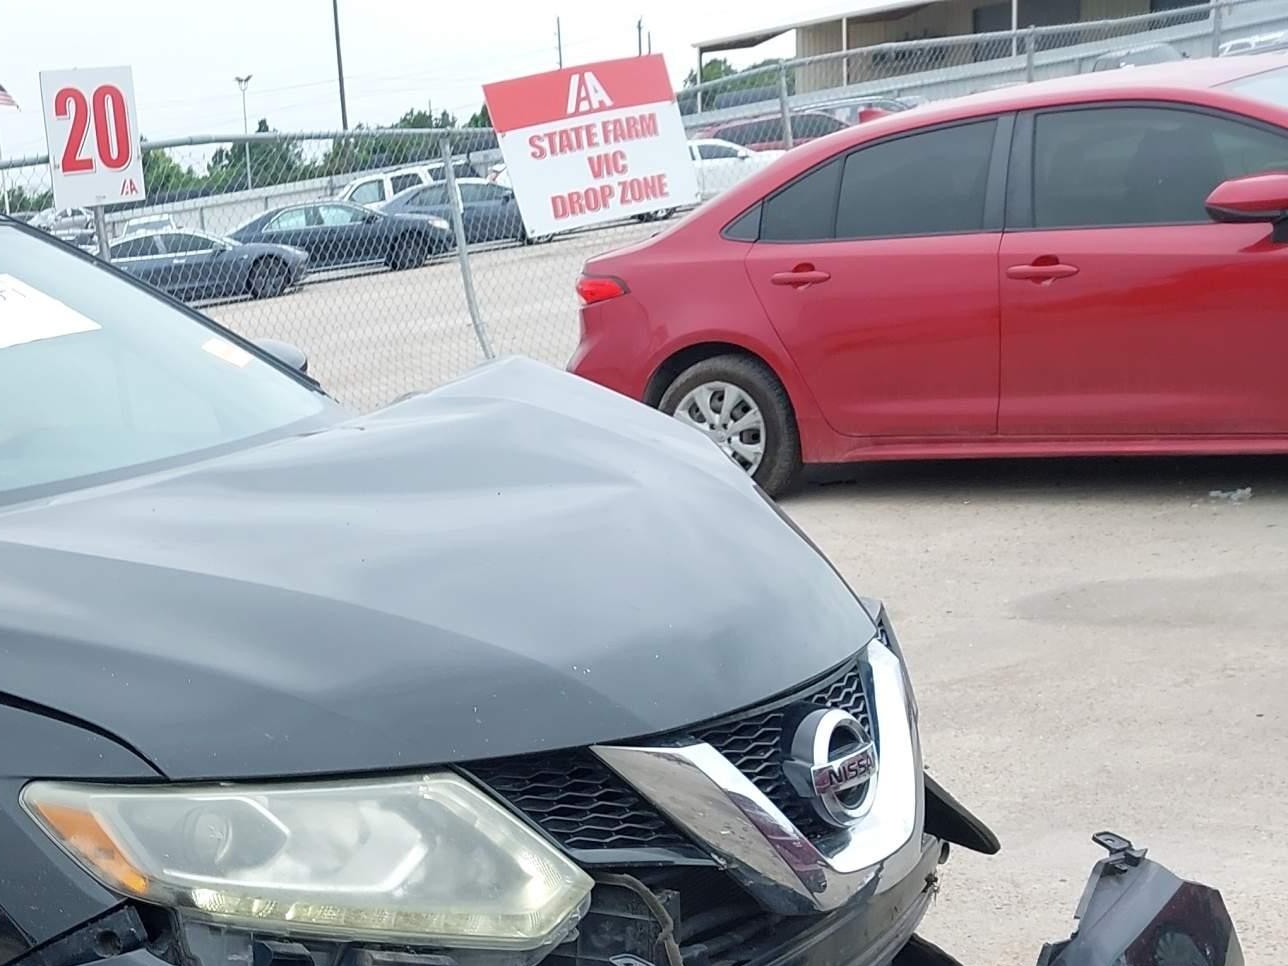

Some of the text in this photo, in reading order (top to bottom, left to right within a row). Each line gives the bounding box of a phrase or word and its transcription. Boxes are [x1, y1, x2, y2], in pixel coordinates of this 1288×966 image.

[54, 84, 132, 174] 20
[528, 112, 659, 160] STATE FARM
[587, 150, 629, 179] VIC
[551, 173, 670, 220] DROP ZONE
[828, 754, 873, 786] NISSA
